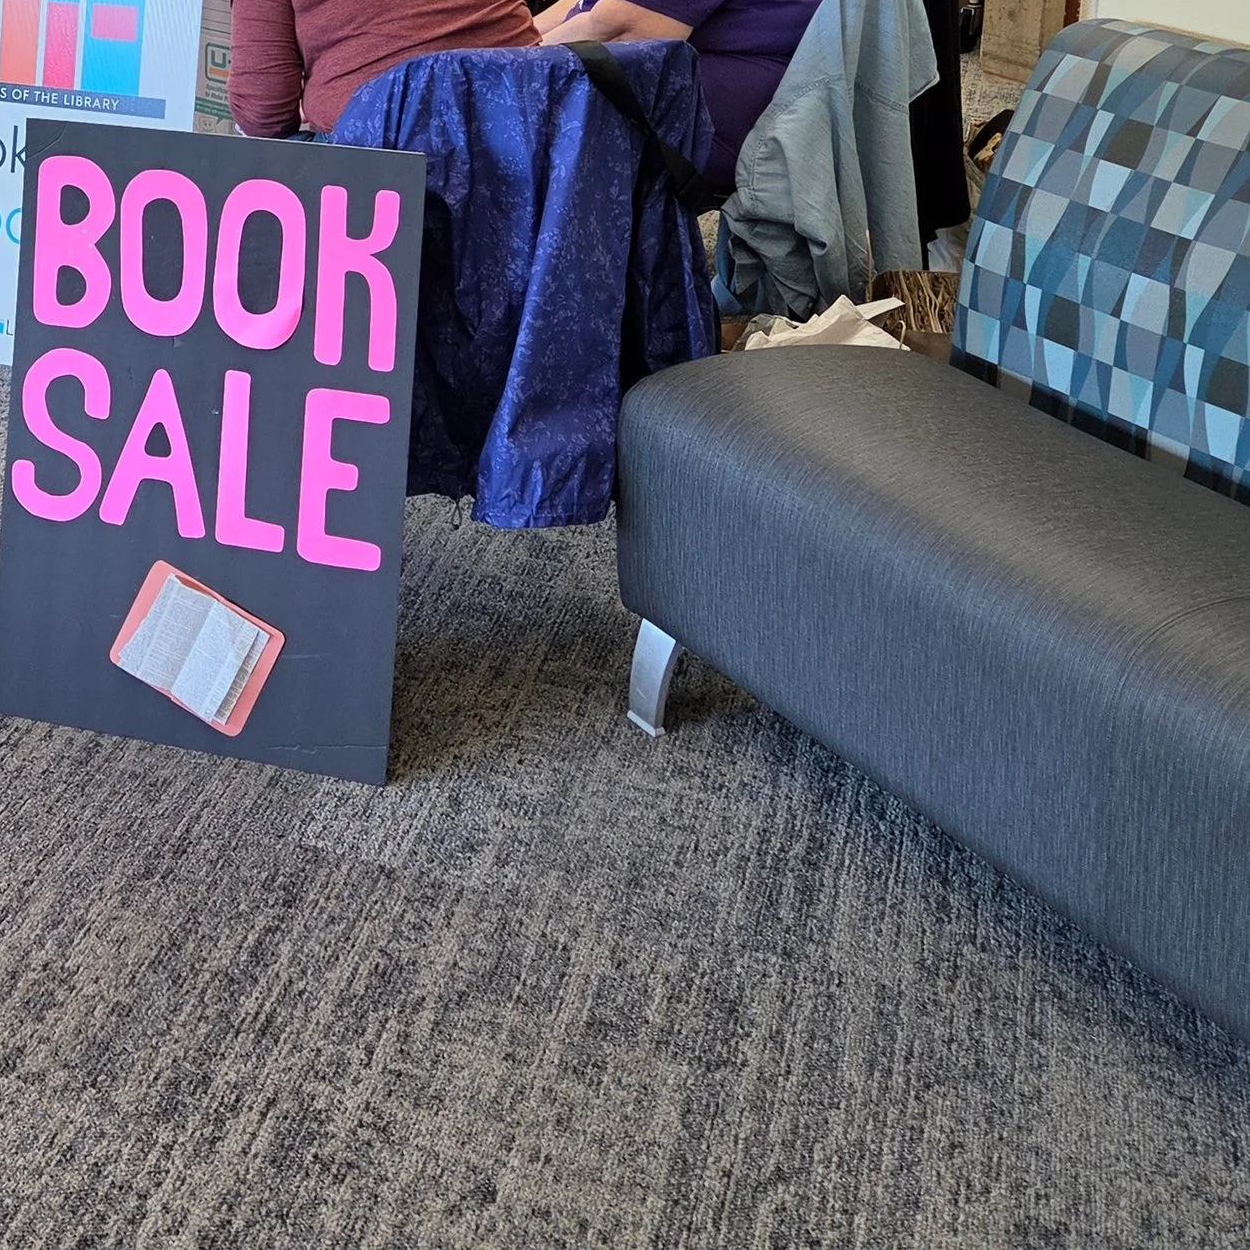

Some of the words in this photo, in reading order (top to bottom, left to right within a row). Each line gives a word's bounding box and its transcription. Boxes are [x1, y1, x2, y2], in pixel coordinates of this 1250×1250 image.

[11, 88, 30, 101] OF
[33, 90, 59, 105] THE
[62, 94, 120, 111] LIBRARY
[32, 154, 401, 373] BOOK
[11, 347, 391, 572] SALE
